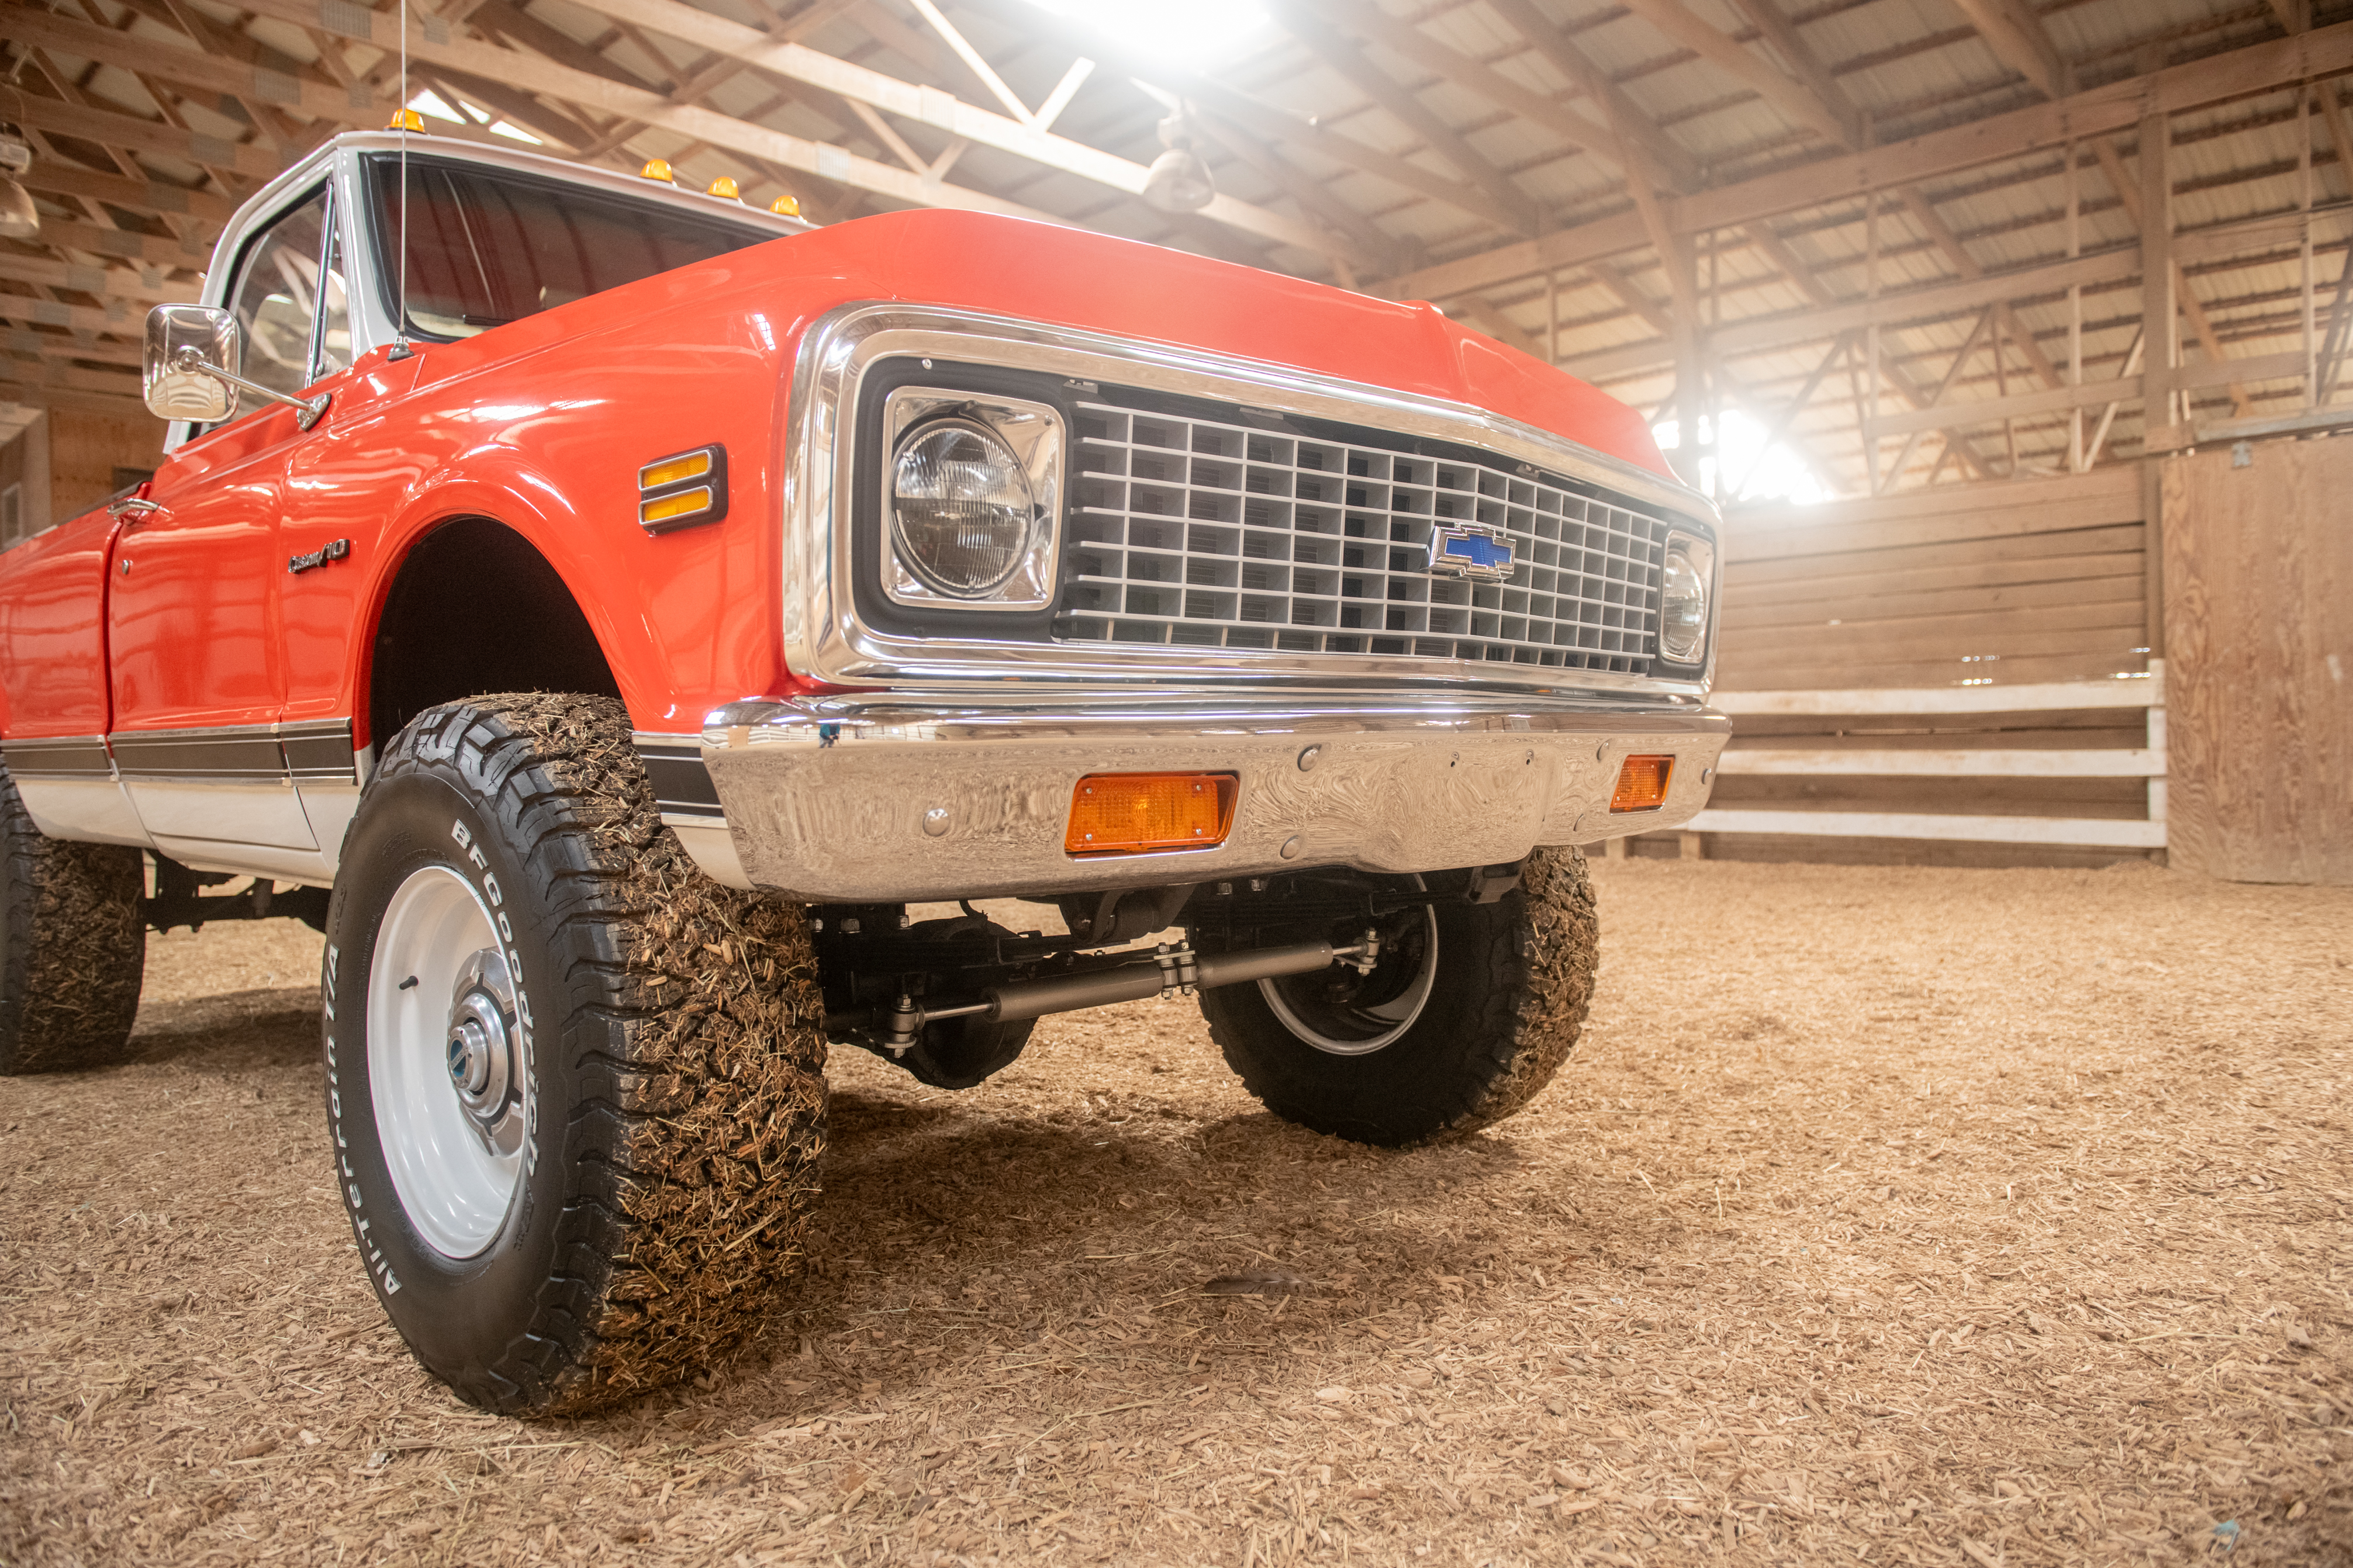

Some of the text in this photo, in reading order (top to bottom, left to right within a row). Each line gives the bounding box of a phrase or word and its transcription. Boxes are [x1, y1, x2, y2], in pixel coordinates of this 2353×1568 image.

[326, 943, 402, 1295] All-Terrain T/A
[451, 819, 539, 1176] BFGoodrich
